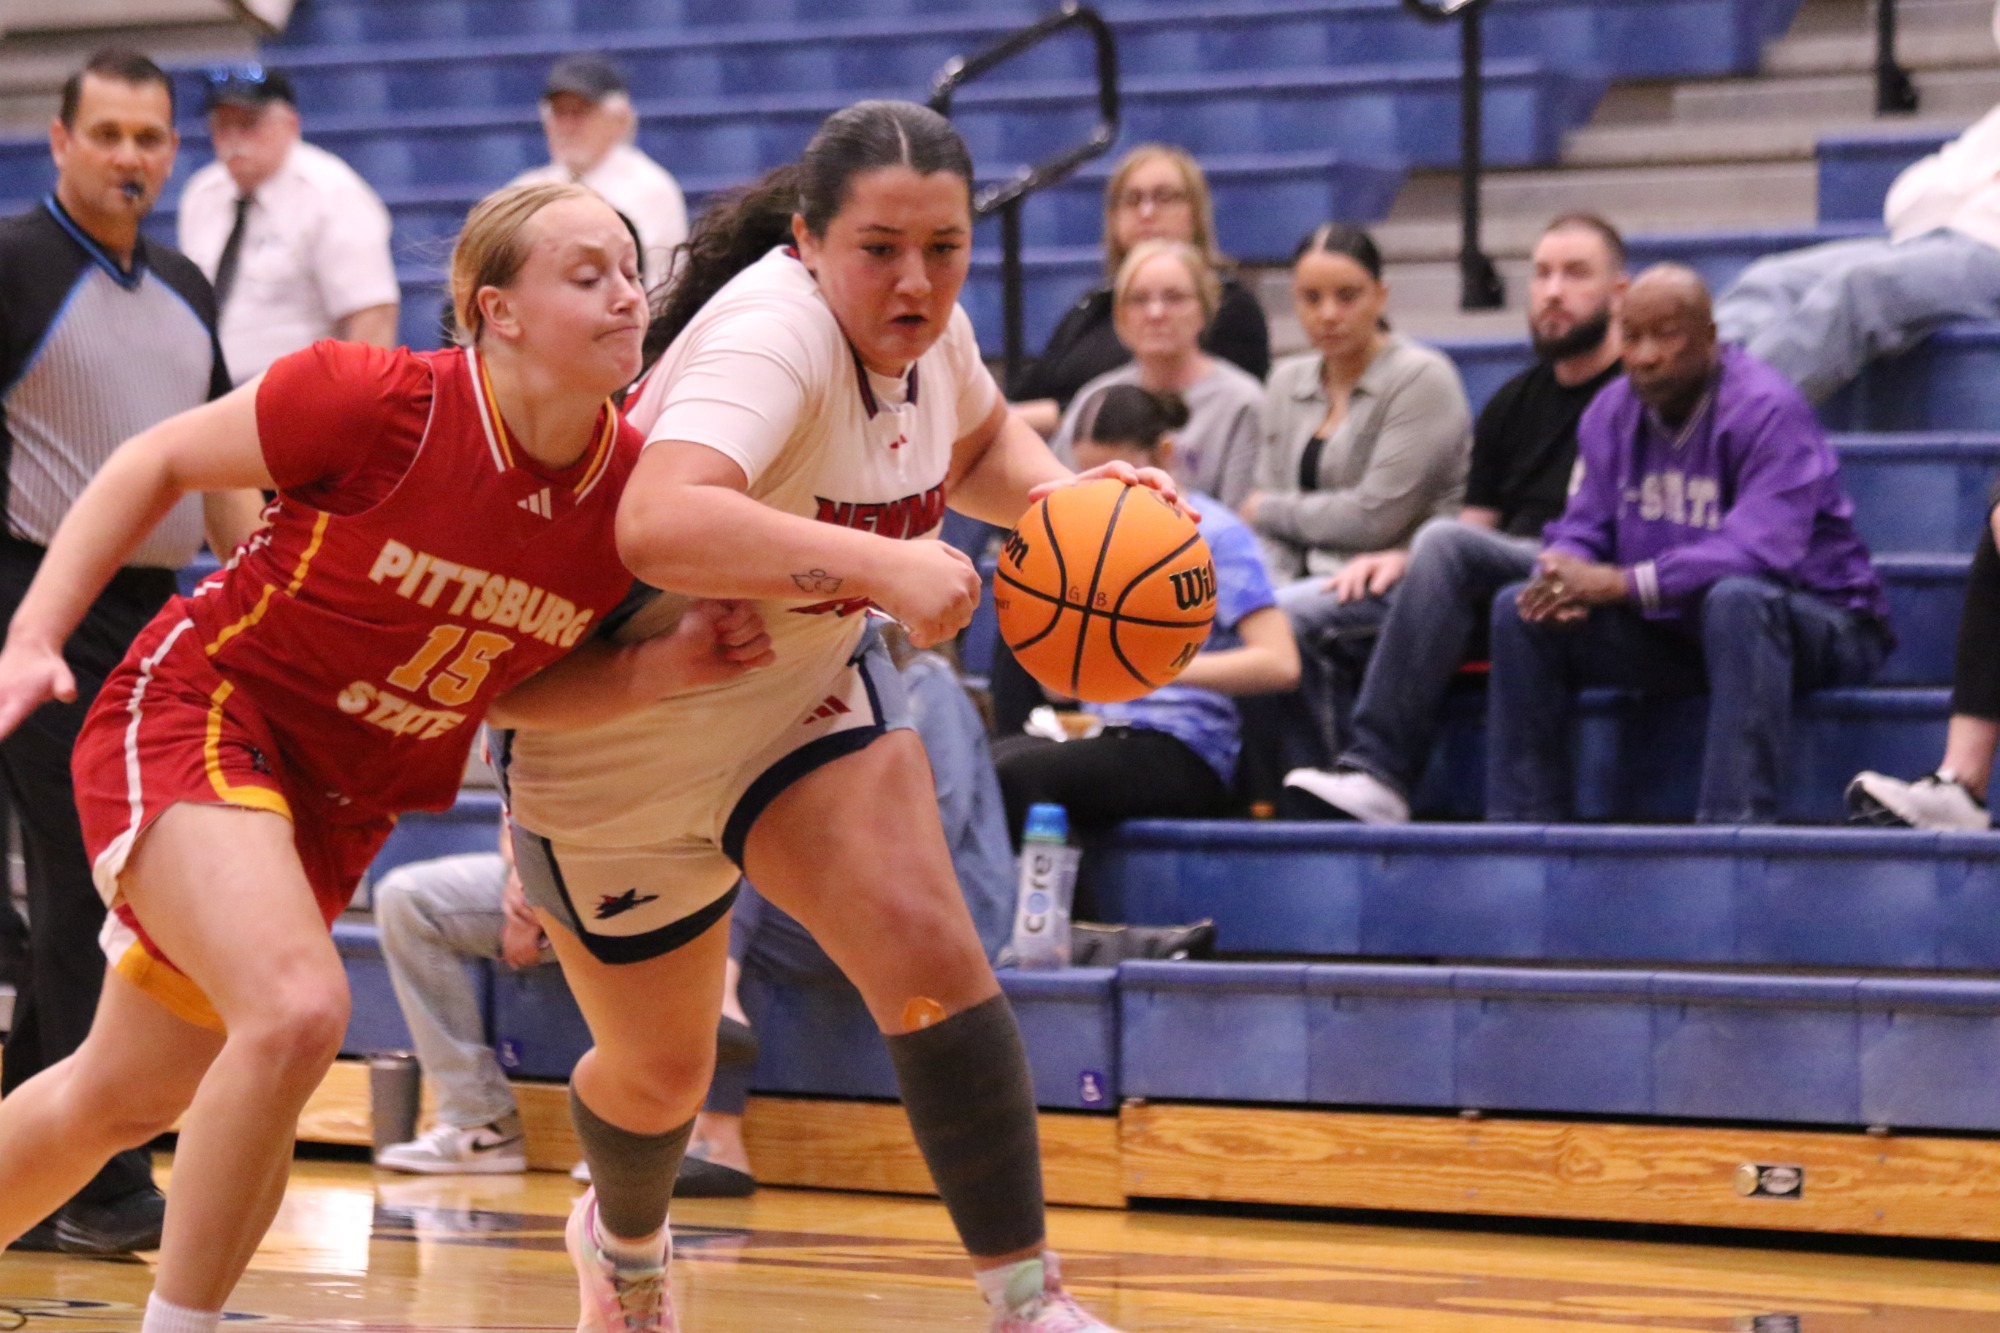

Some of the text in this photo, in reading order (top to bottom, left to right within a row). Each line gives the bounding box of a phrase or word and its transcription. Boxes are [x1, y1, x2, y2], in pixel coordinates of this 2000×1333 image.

[368, 538, 595, 648] PITTSBURG
[1168, 557, 1218, 612] Wil
[386, 623, 515, 706] 15
[336, 680, 467, 740] STATE
